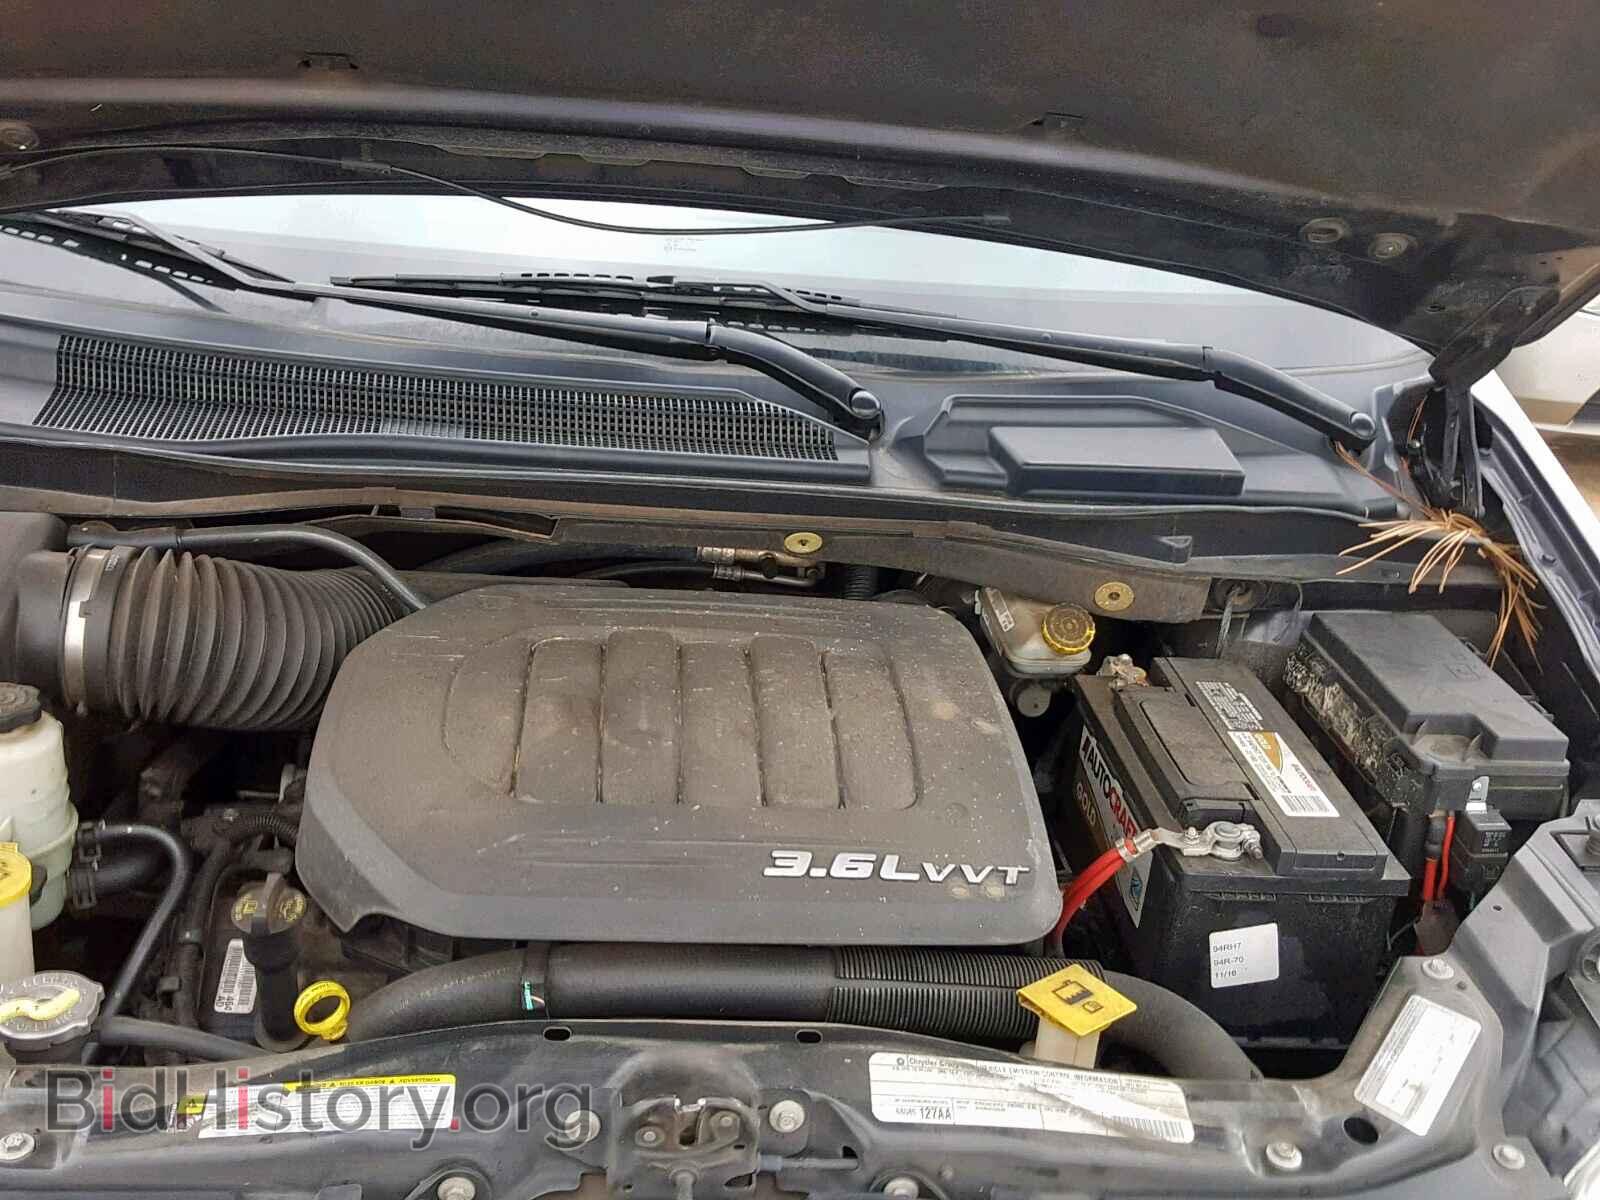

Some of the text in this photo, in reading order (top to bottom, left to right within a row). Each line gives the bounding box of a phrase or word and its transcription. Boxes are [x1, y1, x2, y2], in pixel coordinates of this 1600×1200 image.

[1084, 744, 1139, 843] AUTOCRAF
[763, 850, 1031, 885] 3.6L VVT
[909, 1057, 937, 1067] Chrysler
